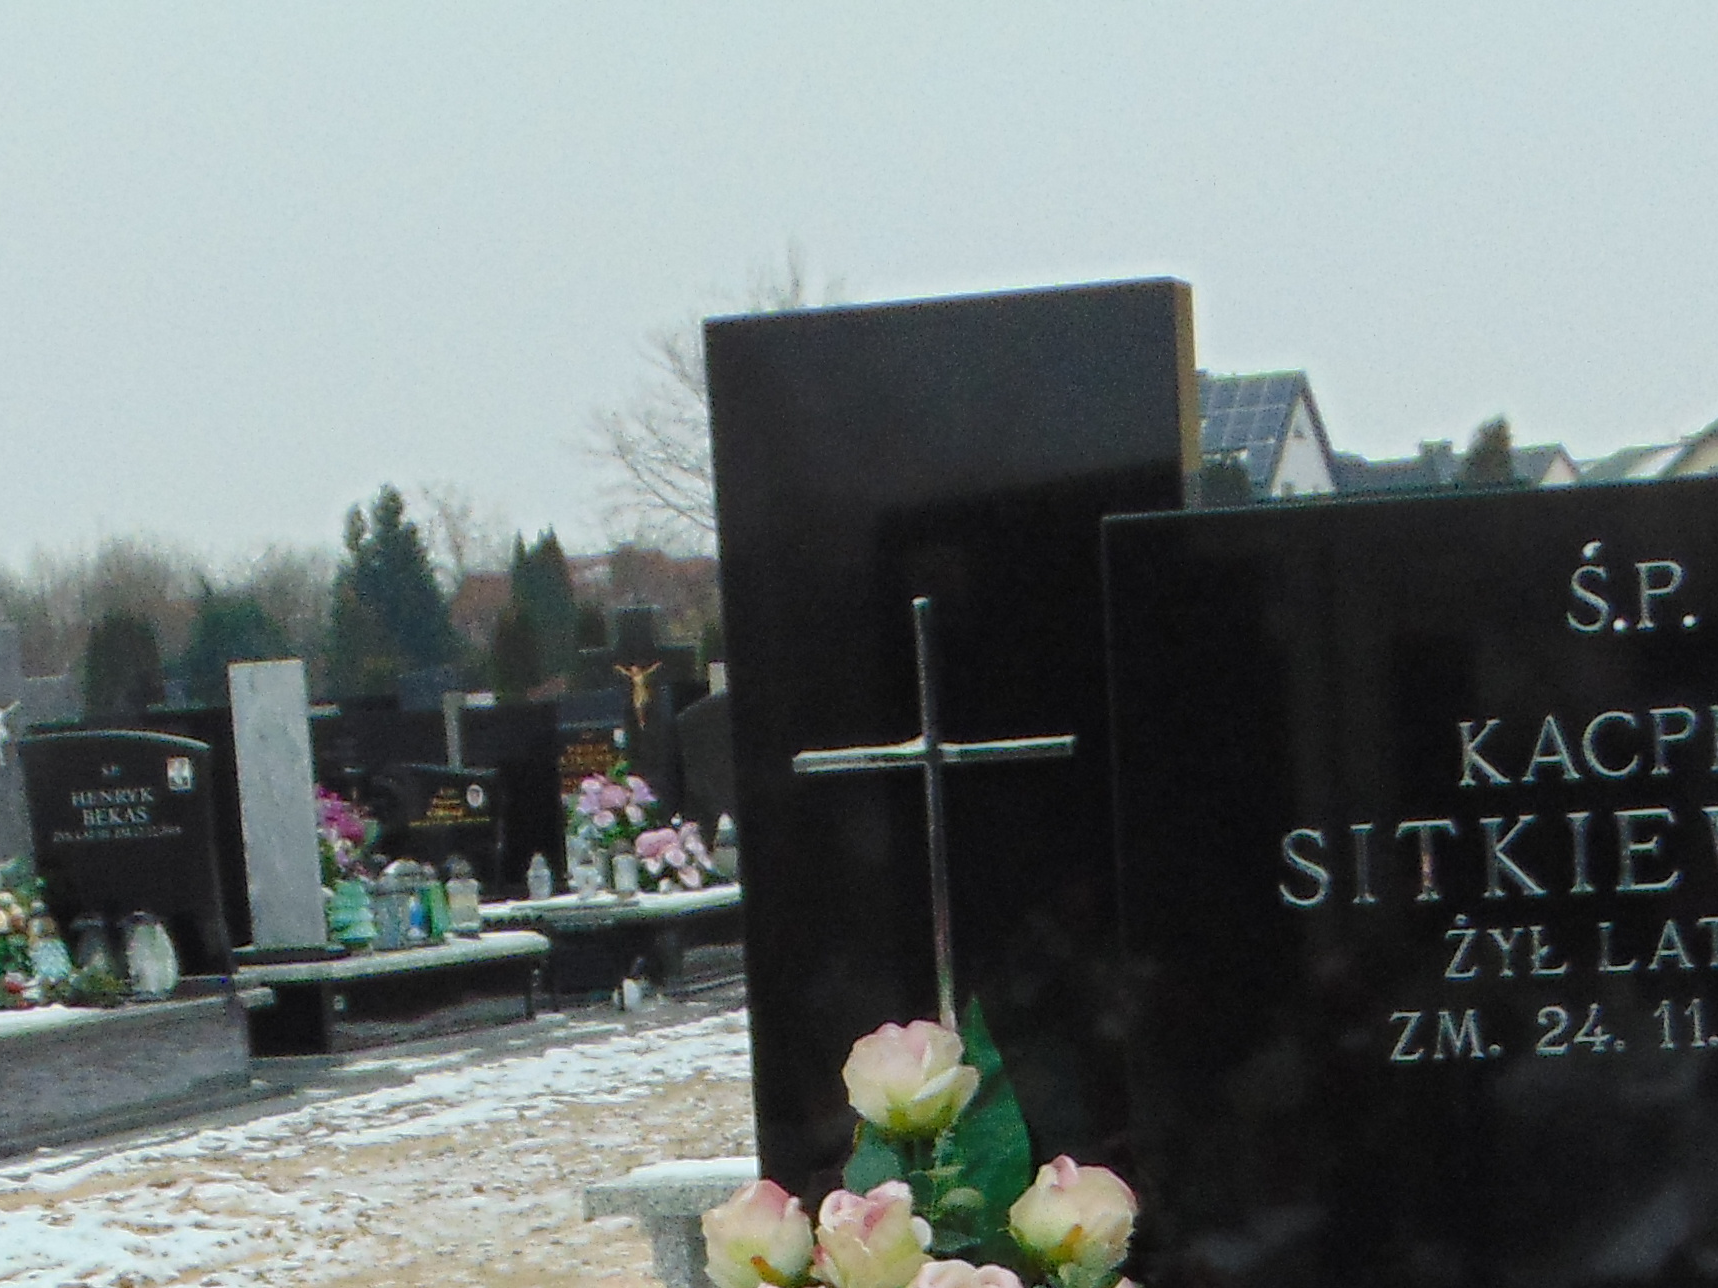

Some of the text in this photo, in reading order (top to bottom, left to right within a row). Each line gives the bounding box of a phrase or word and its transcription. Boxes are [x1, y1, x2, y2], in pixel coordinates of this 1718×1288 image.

[1566, 539, 1697, 633] Ś.P.
[1443, 912, 1569, 981] ŻYŁ
[1388, 1008, 1502, 1063] ZM.
